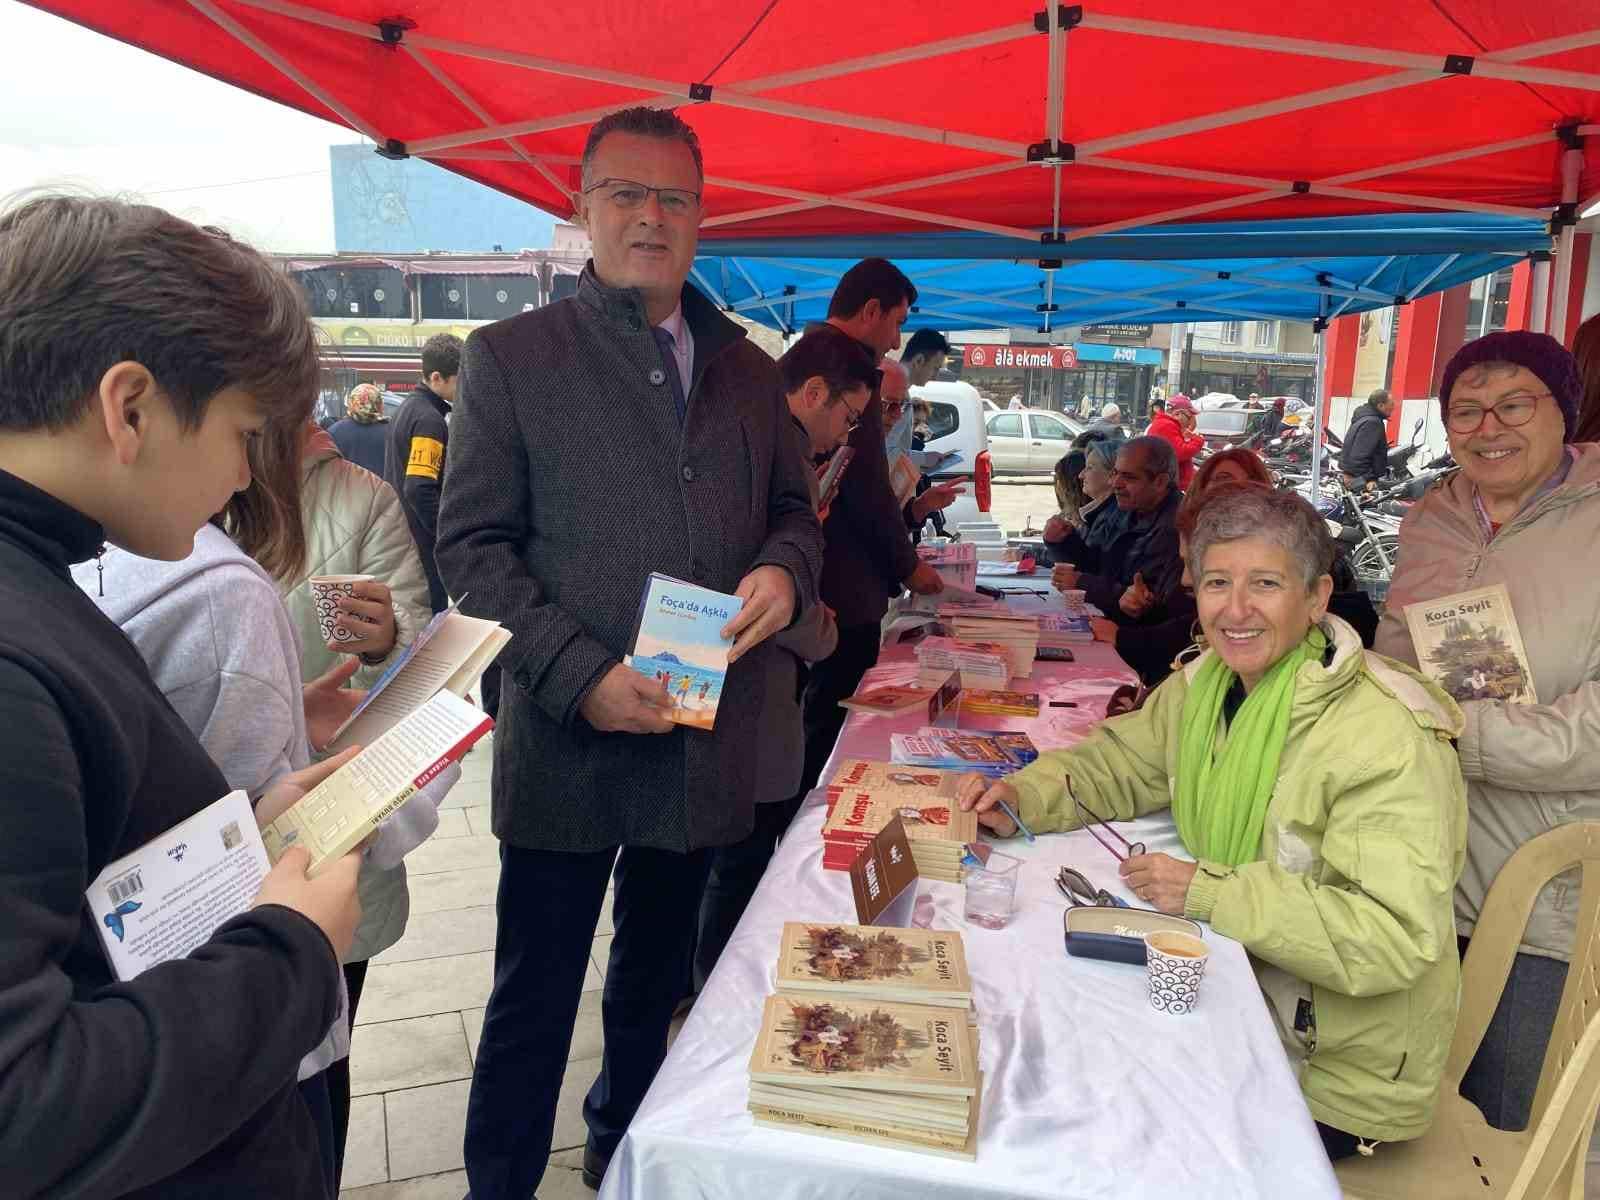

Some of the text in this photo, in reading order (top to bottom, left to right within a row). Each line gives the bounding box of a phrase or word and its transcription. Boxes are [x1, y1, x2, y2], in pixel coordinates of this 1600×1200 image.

[1016, 350, 1054, 367] ekmek
[660, 595, 699, 612] Foça'da
[1425, 600, 1492, 622] Koca Seyit
[845, 793, 873, 826] Komşu
[935, 941, 947, 959] Koca
[935, 1020, 954, 1072] Koca Seyit
